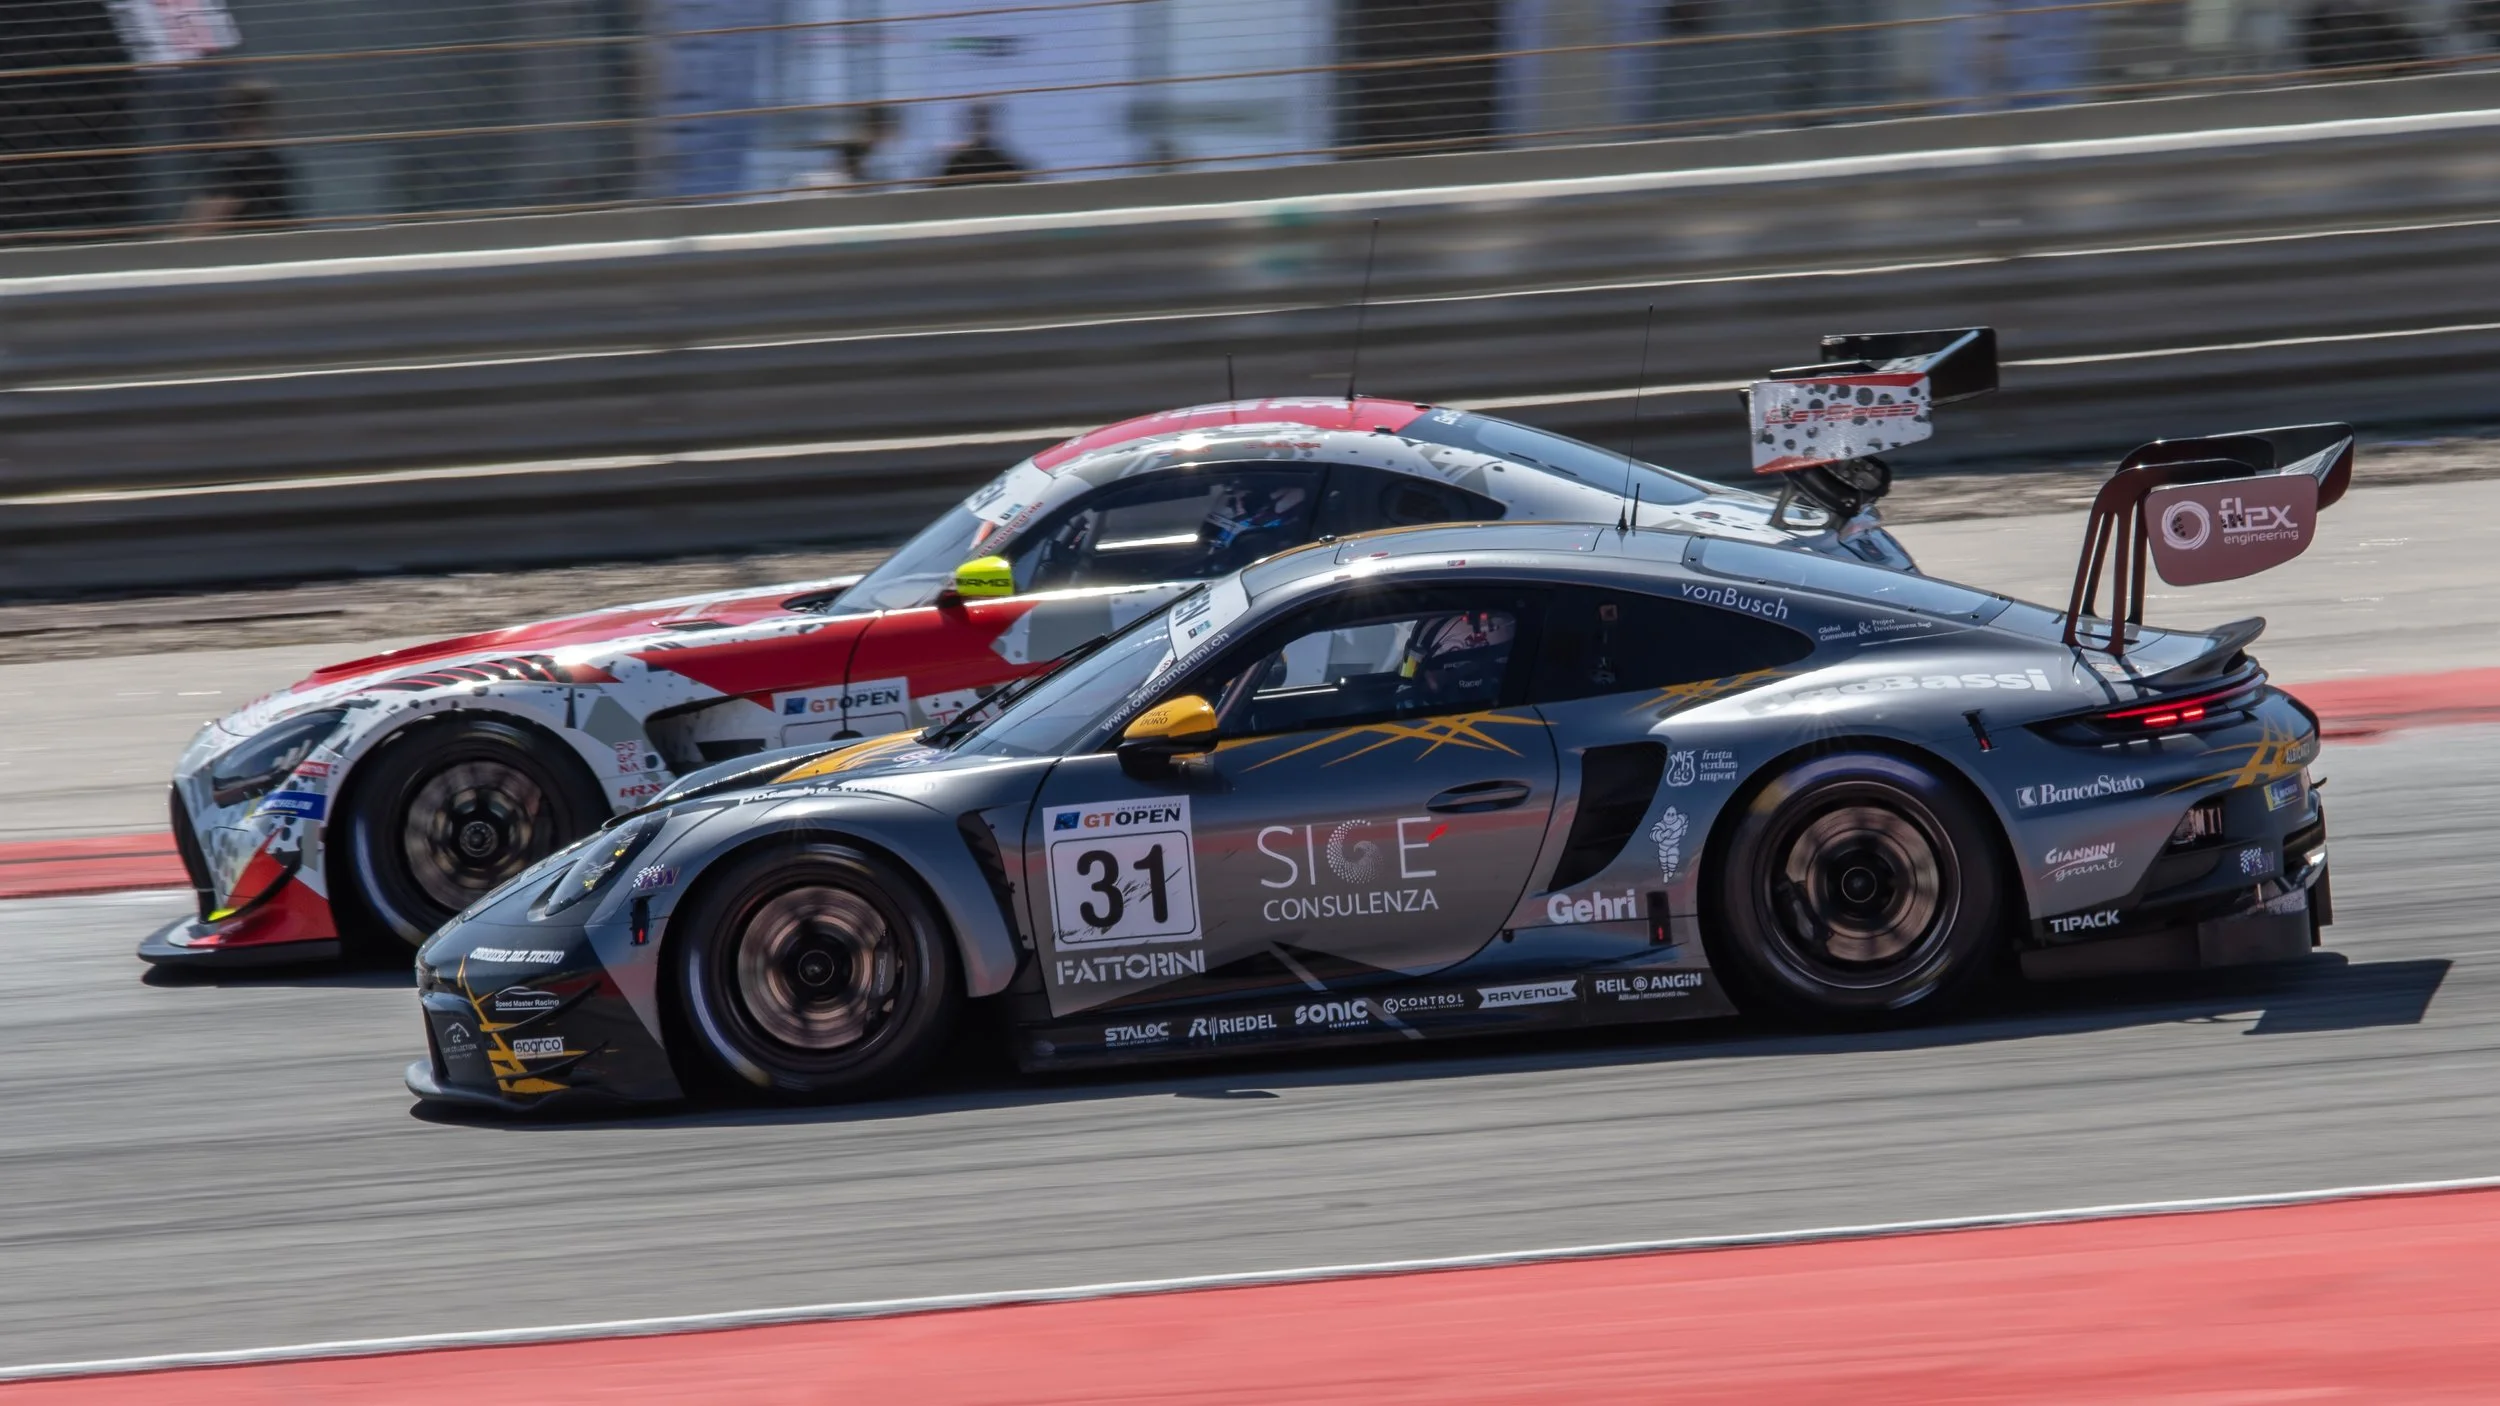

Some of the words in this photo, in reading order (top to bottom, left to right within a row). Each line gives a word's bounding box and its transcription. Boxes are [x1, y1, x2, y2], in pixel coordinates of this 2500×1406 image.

[2224, 530, 2299, 546] engineering
[1681, 583, 1788, 619] vonBusch
[1818, 625, 1841, 634] Global
[1858, 621, 1872, 635] &
[1872, 618, 1895, 627] Project
[1874, 623, 1917, 632] Development
[1820, 631, 1857, 641] Consulting
[1702, 750, 1732, 760] frutta
[1700, 770, 1736, 782] import
[2038, 775, 2145, 806] BancaStato
[2045, 842, 2116, 864] GIANNINI
[1077, 844, 1169, 928] 31
[1263, 888, 1440, 922] CONSULENZA
[1547, 888, 1637, 925] Gehri
[2050, 909, 2120, 933] TIPACK
[1057, 950, 1206, 985] FATTORINI
[1595, 978, 1631, 994] REIL
[1400, 994, 1465, 1007] CONTROL
[1488, 987, 1569, 1003] RAVENOL
[495, 1000, 513, 1008] Speed
[534, 999, 560, 1007] Racing
[1105, 1022, 1169, 1041] STALOC
[1220, 1014, 1277, 1034] RIEDEL
[1329, 1020, 1369, 1028] equipment
[515, 1039, 561, 1053] sparco
